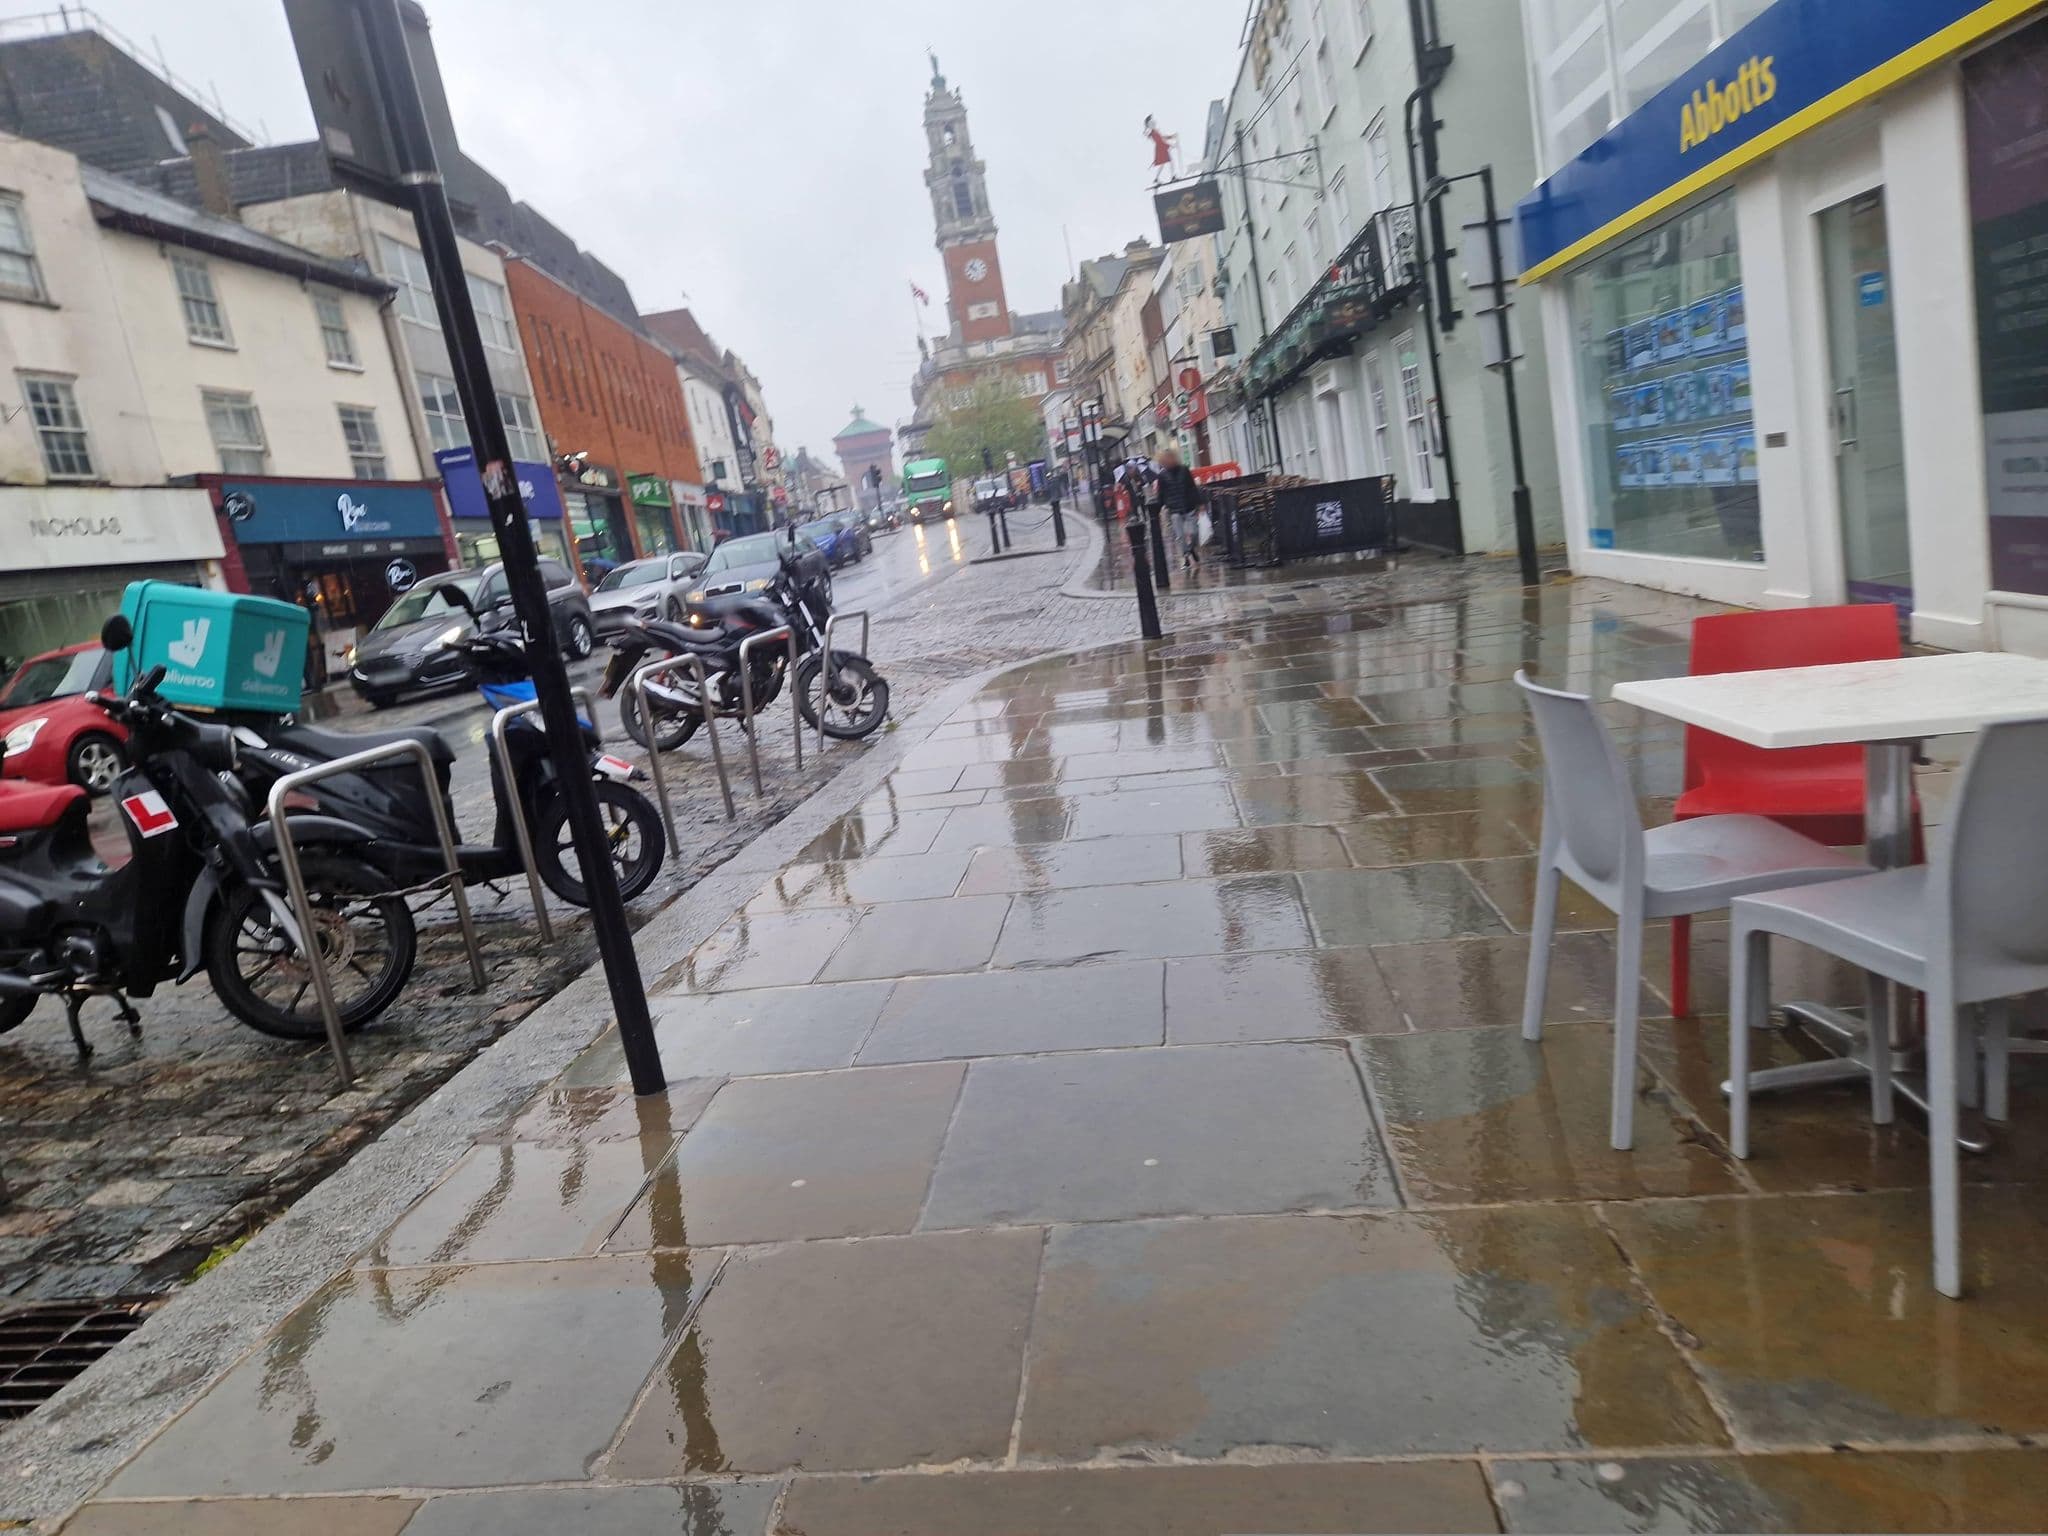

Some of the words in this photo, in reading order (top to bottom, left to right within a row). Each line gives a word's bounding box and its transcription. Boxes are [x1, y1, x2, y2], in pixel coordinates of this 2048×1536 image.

[1680, 56, 1776, 154] Abbotts
[30, 517, 122, 537] NICHOLAS
[163, 669, 216, 689] eliveroo
[241, 679, 288, 697] deliveroo
[124, 796, 174, 833] L
